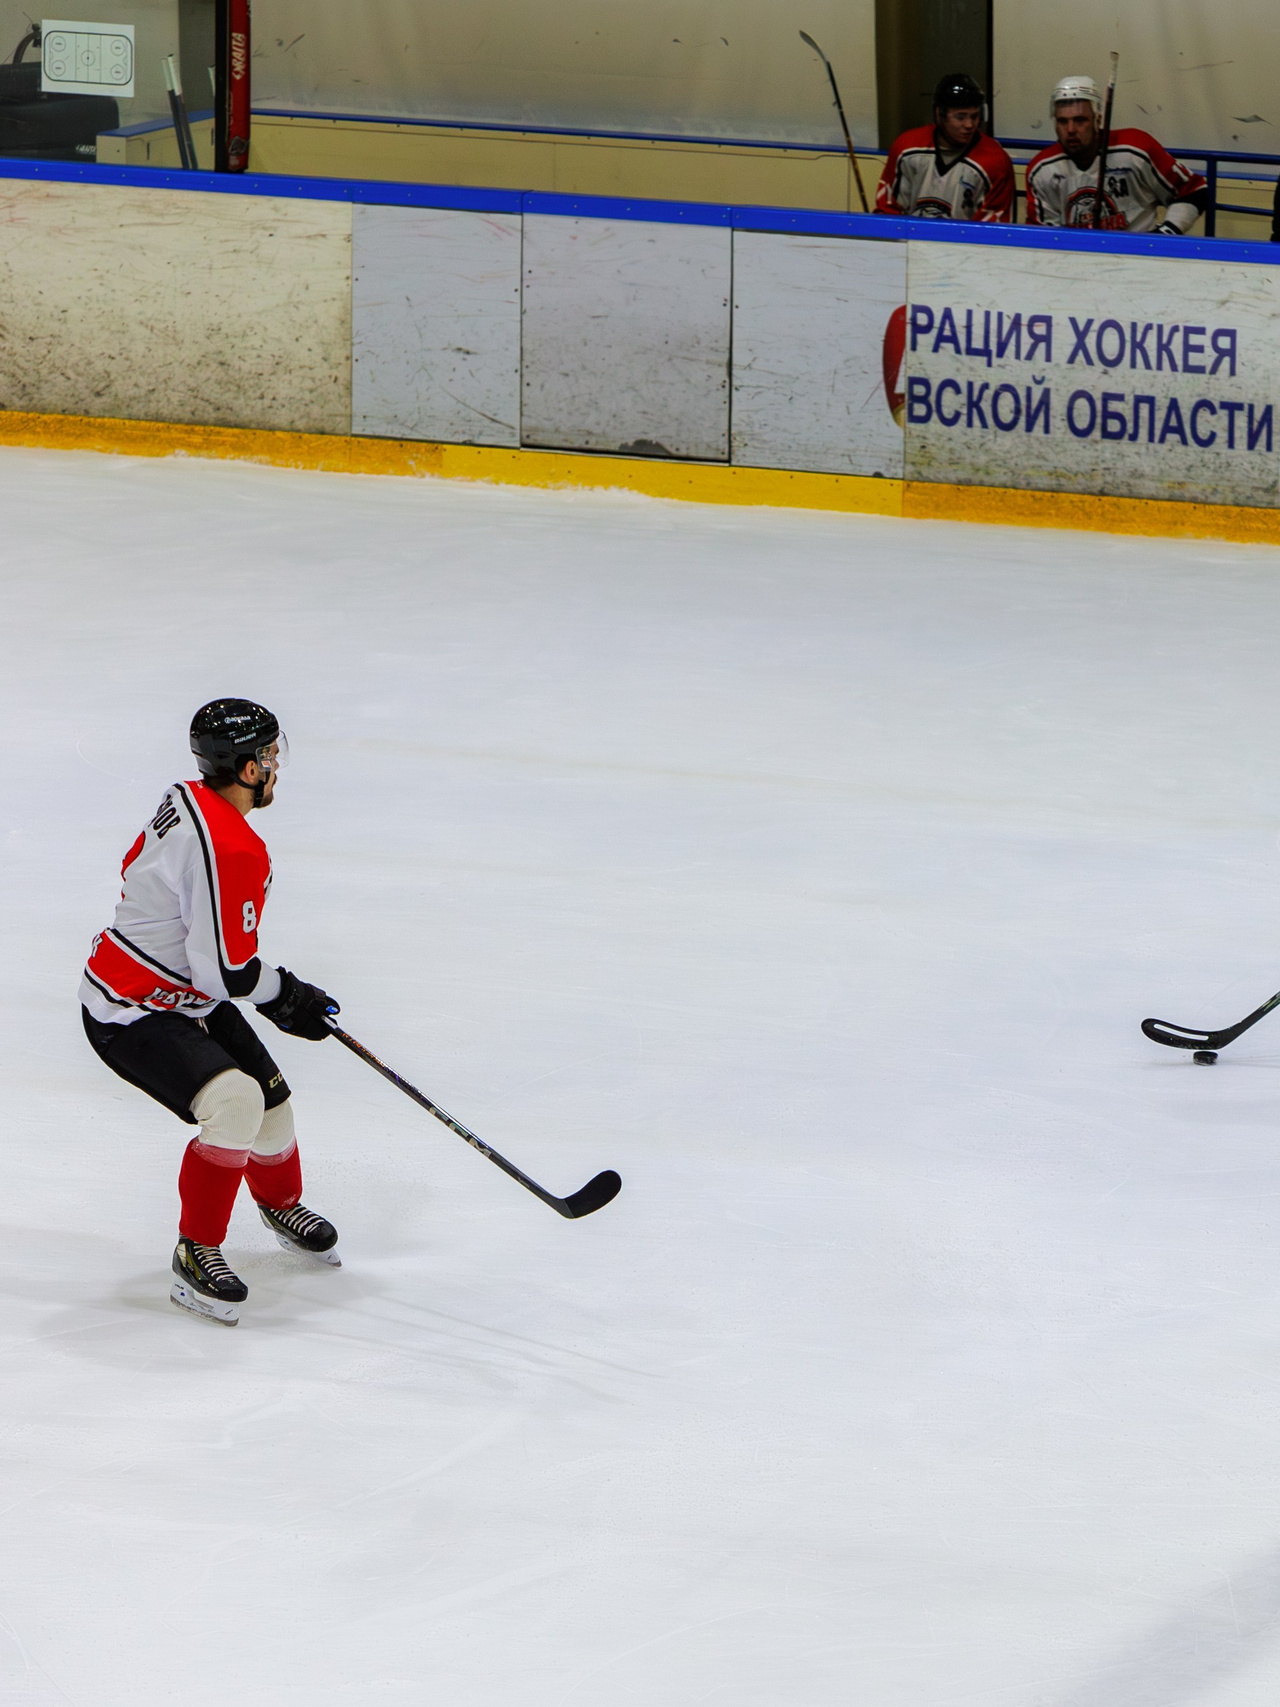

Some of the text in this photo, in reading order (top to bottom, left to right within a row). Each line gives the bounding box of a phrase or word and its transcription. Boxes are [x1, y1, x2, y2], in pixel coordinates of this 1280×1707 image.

[909, 304, 1238, 377] РАЦИЯ ХОККЕЯ
[907, 376, 1273, 453] ВСКОЙ ОБЛАСТИ
[241, 900, 257, 933] 8
